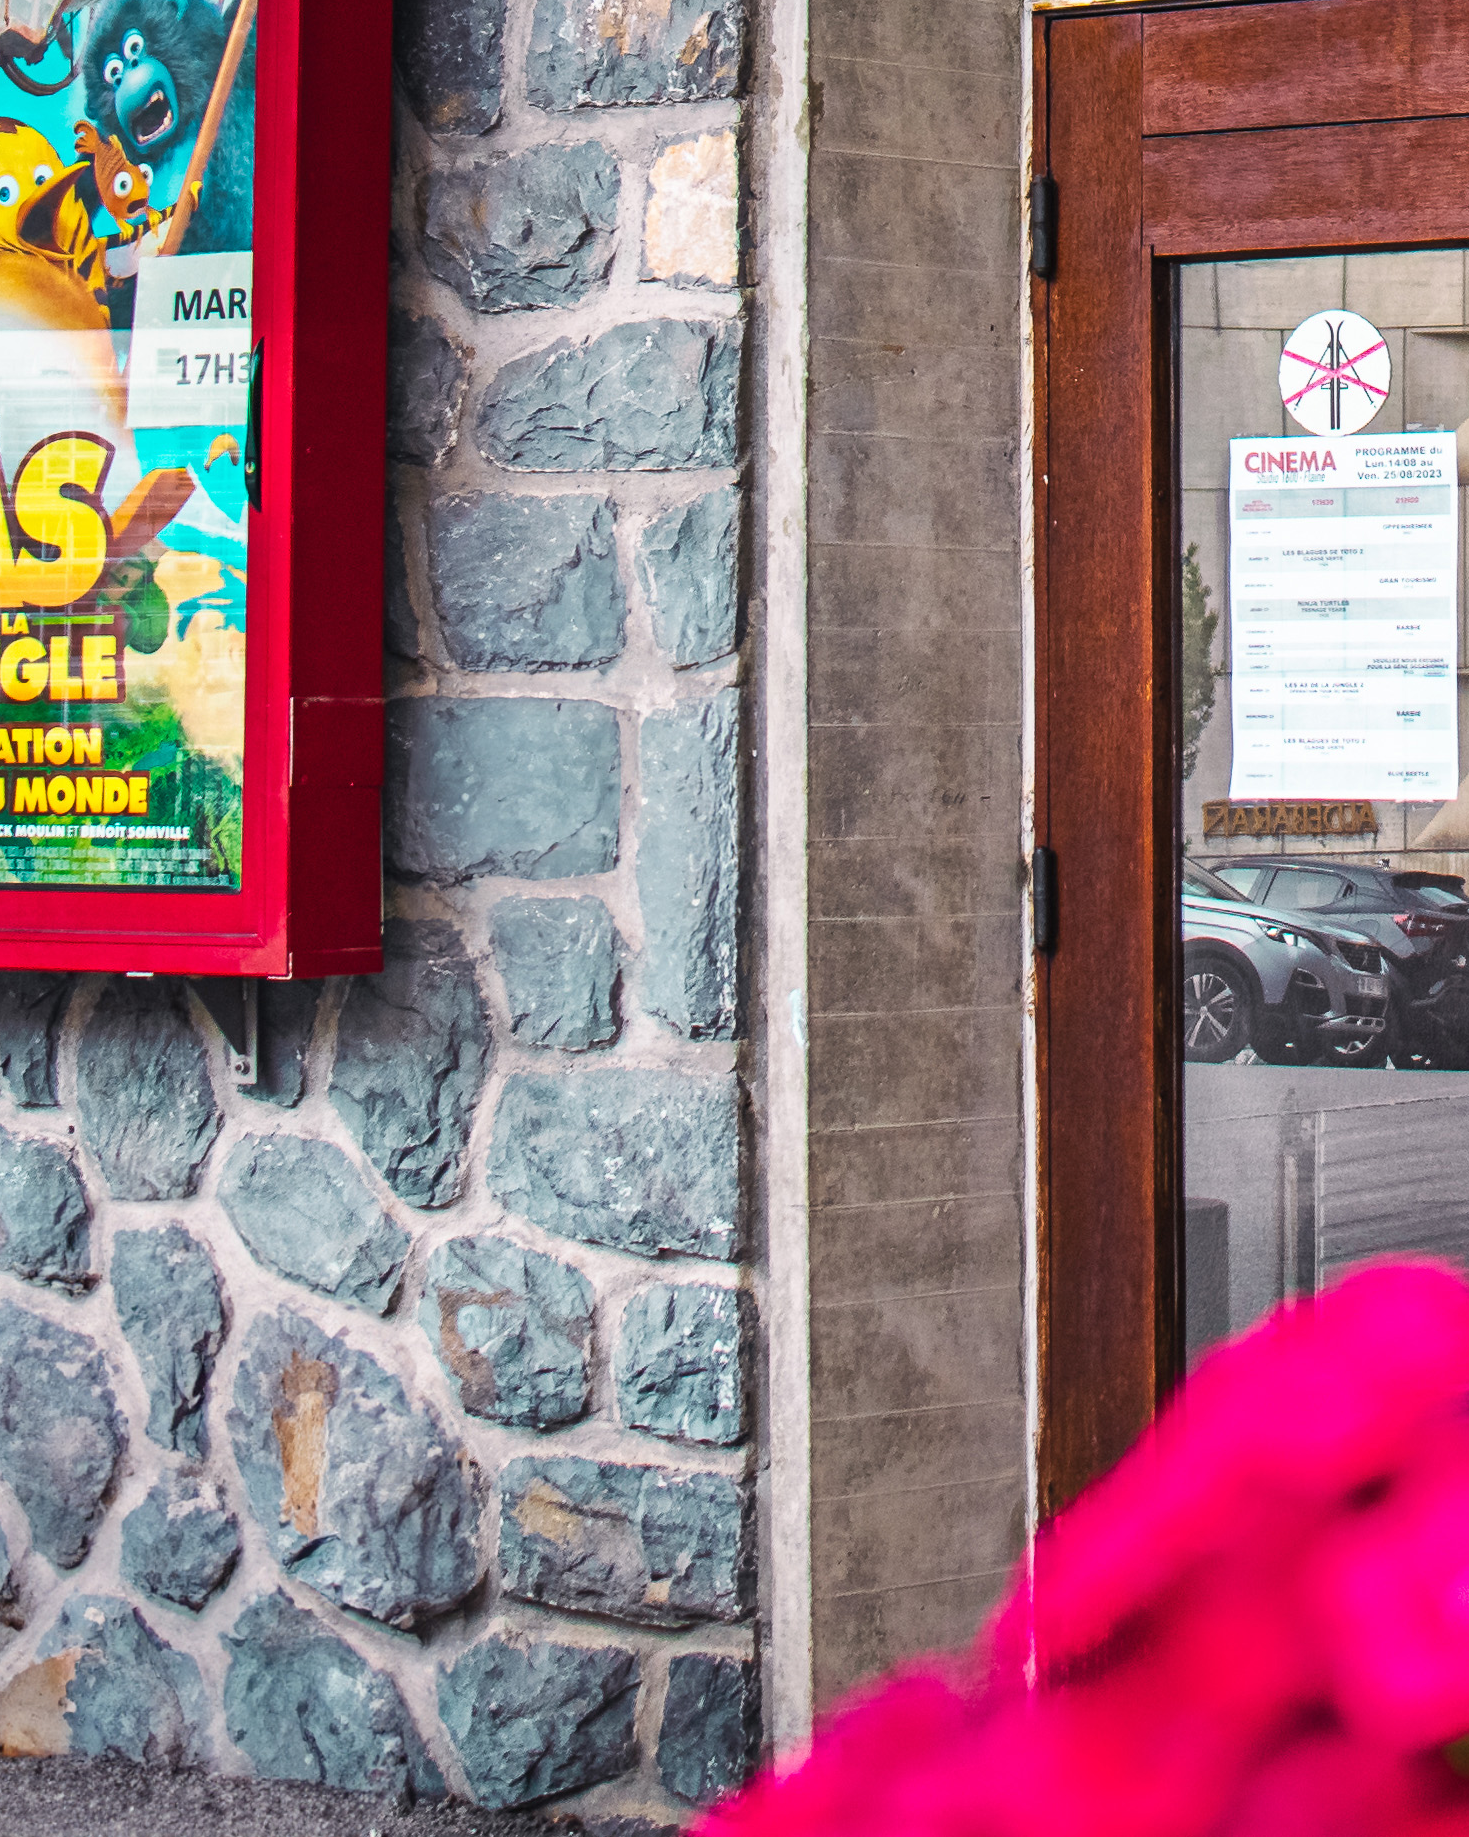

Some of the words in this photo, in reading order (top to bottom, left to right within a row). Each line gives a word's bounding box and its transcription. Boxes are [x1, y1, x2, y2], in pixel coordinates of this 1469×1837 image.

[1355, 446, 1427, 457] PROGRAMME
[1429, 446, 1443, 455] du
[1244, 449, 1338, 474] CINEMA
[1420, 459, 1434, 467] au
[1357, 471, 1380, 481] Ven.
[0, 611, 30, 636] LA
[13, 774, 149, 814] MONDE
[15, 824, 65, 837] MOULIN
[67, 825, 79, 837] ET
[80, 821, 127, 838] BENOÎT
[127, 825, 191, 839] SOMVILLE
